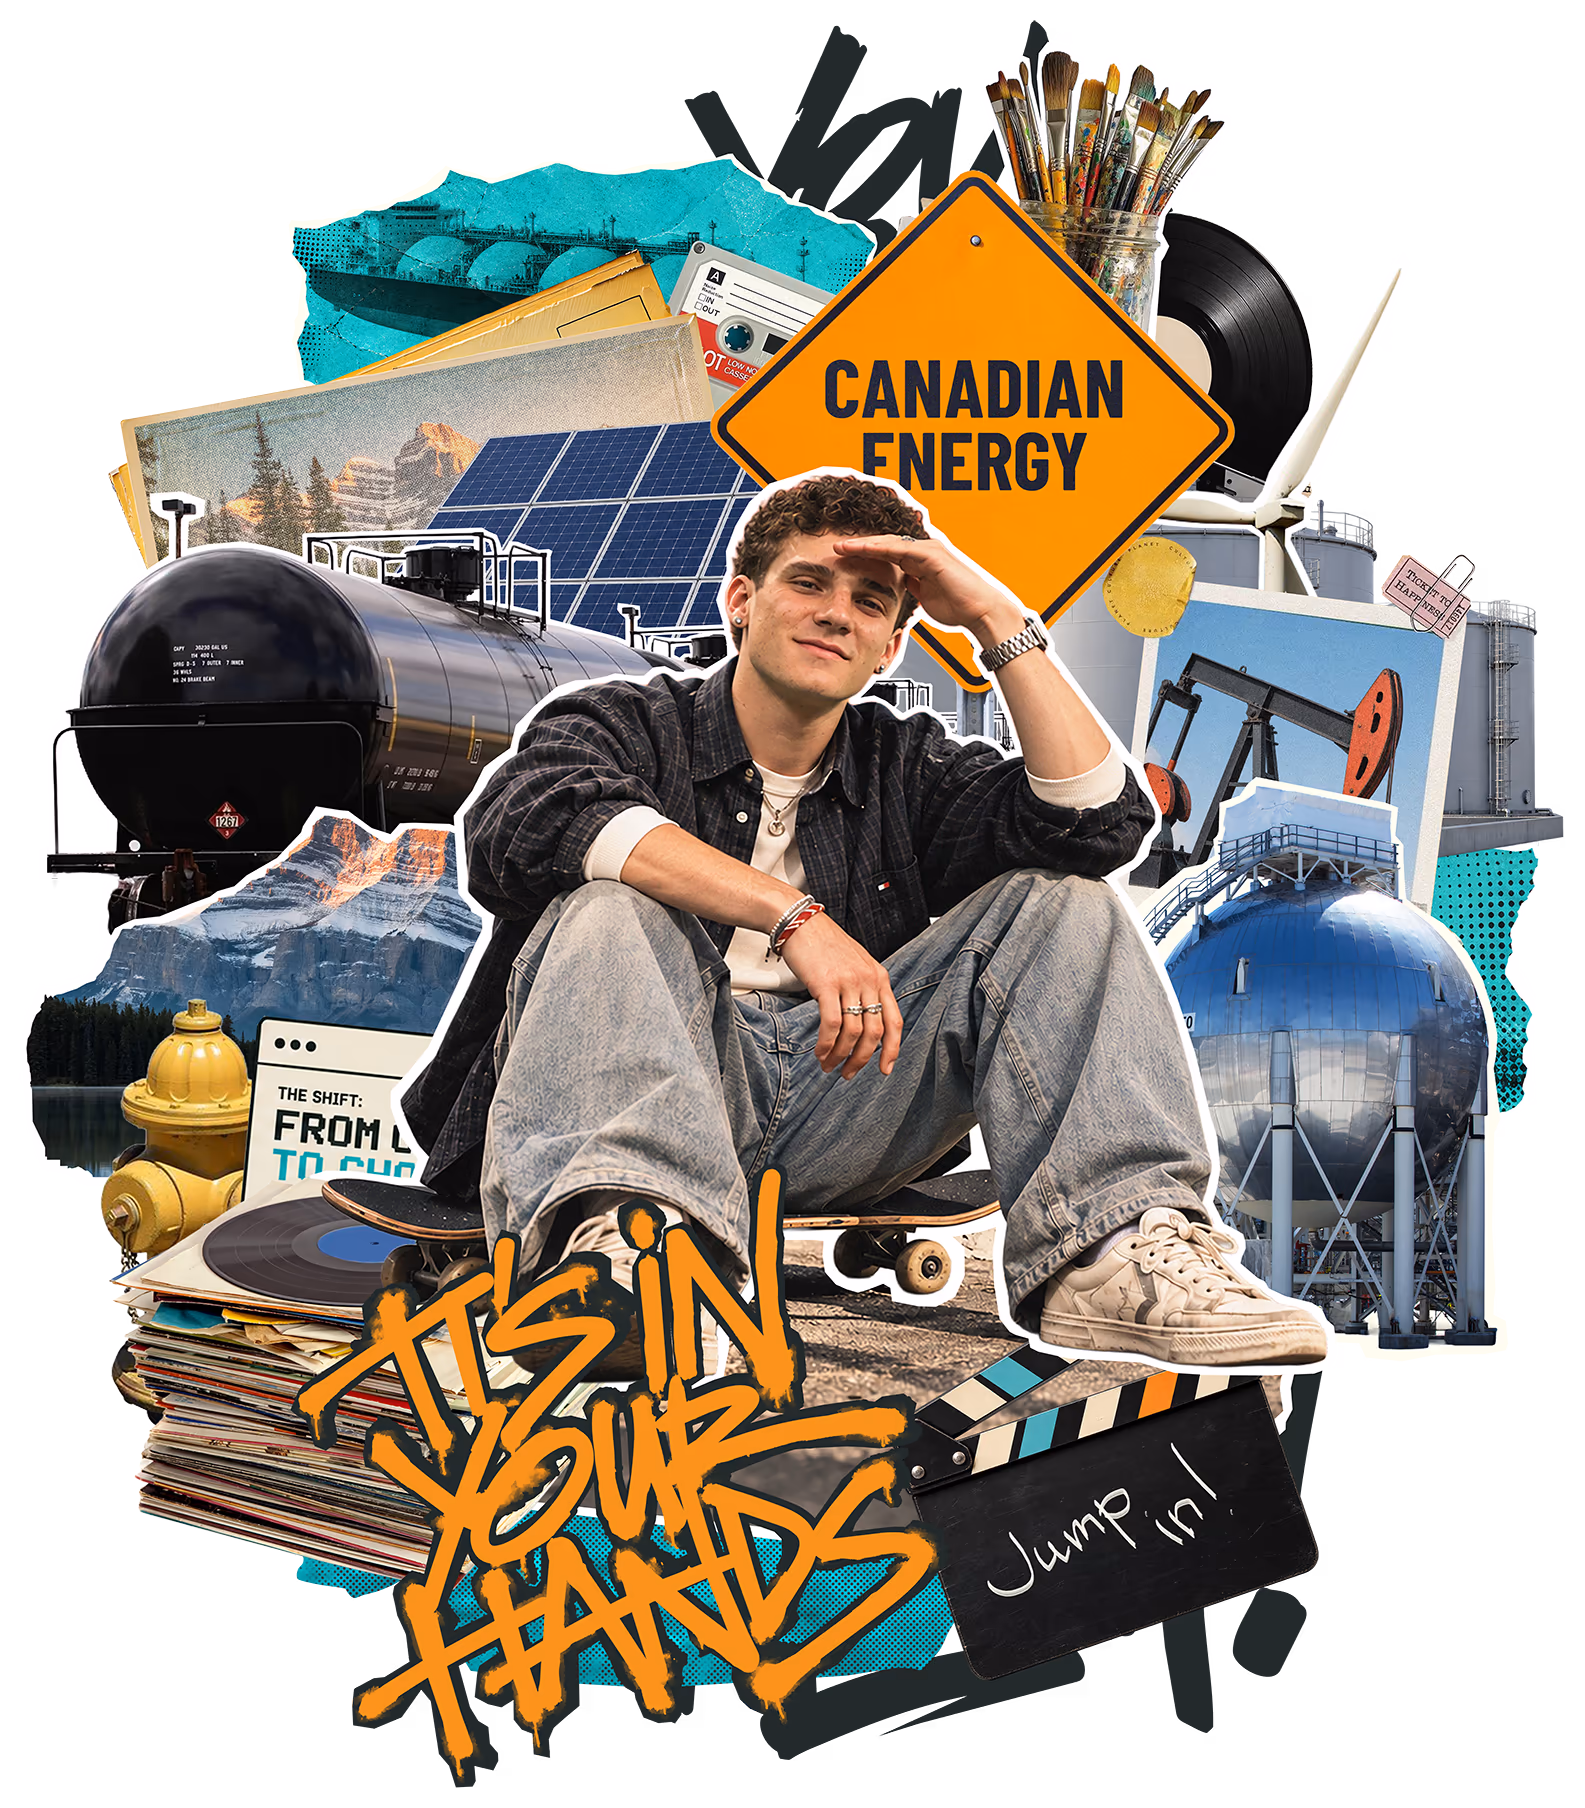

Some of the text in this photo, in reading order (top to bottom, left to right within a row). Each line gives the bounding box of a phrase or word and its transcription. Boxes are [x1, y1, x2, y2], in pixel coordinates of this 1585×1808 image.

[710, 271, 720, 282] A
[702, 305, 721, 317] OUT
[705, 296, 715, 305] IN
[727, 359, 746, 371] LOW
[825, 359, 1123, 418] CANADIAN
[863, 432, 1088, 491] ENERGY
[1439, 595, 1453, 610] TO
[217, 816, 238, 828] 1267
[278, 1086, 363, 1107] THE SHIFT:
[273, 1108, 381, 1151] FROM
[272, 1148, 324, 1181] TO
[986, 1487, 1137, 1598] Jump
[357, 1460, 940, 1782] HANDS
